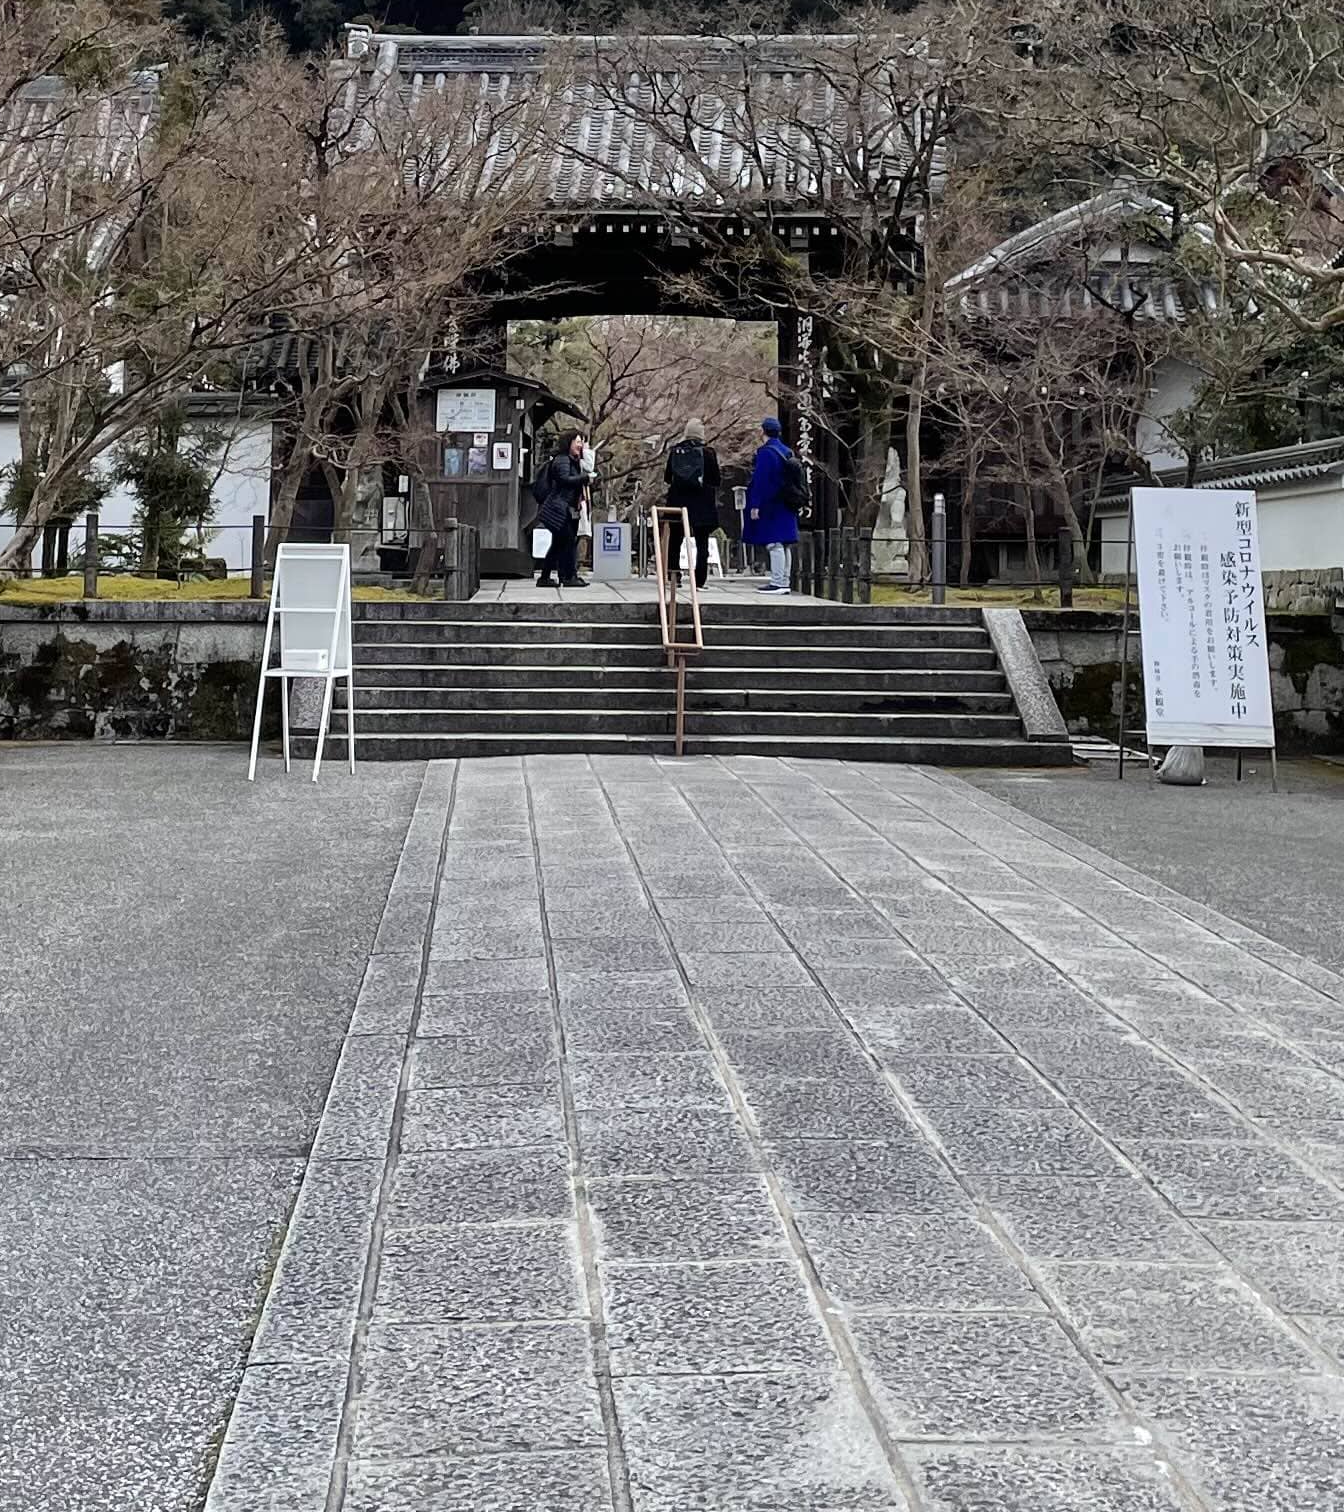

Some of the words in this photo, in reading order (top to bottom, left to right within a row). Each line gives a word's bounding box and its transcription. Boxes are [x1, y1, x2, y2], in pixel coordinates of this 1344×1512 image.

[1220, 551, 1247, 719] 感染予防対策実施中
[1235, 501, 1260, 647] 新型コロナウイルス
